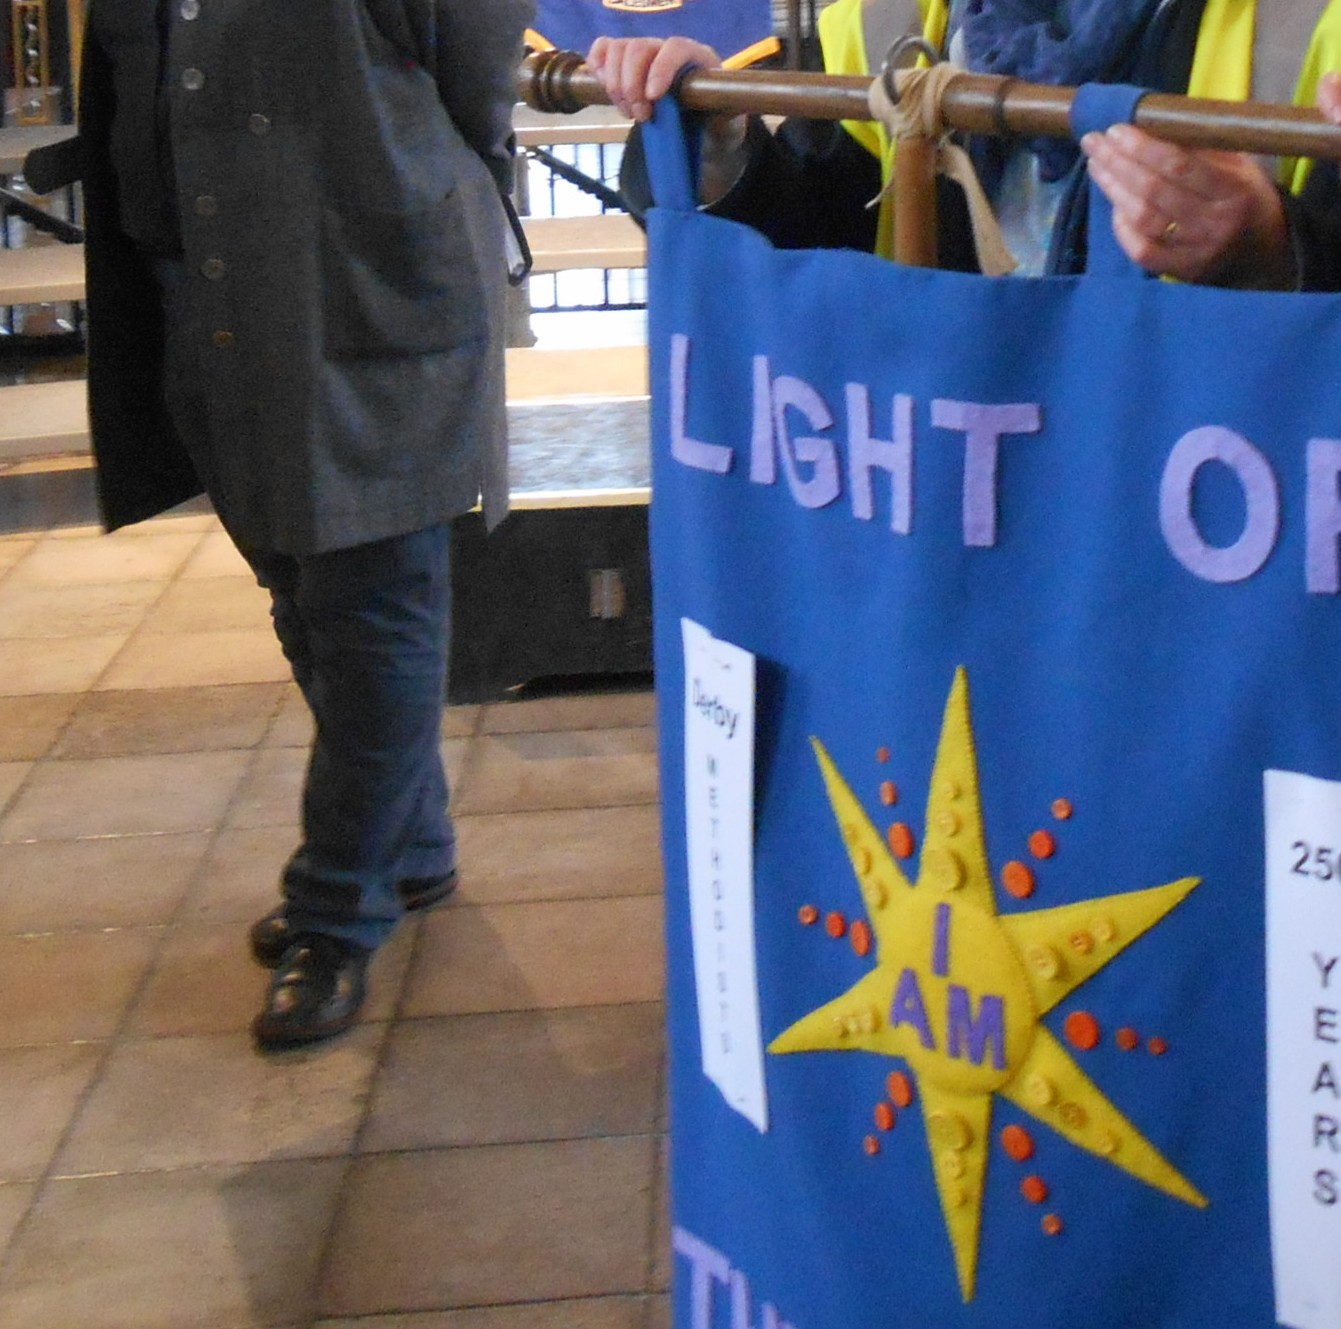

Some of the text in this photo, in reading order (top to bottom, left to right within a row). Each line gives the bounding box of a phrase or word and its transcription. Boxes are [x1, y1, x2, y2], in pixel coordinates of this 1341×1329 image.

[670, 334, 1041, 547] LIGHT
[693, 677, 737, 740] Derby
[931, 902, 951, 977] I
[890, 967, 1007, 1070] AM
[1311, 952, 1341, 1207] YEARS
